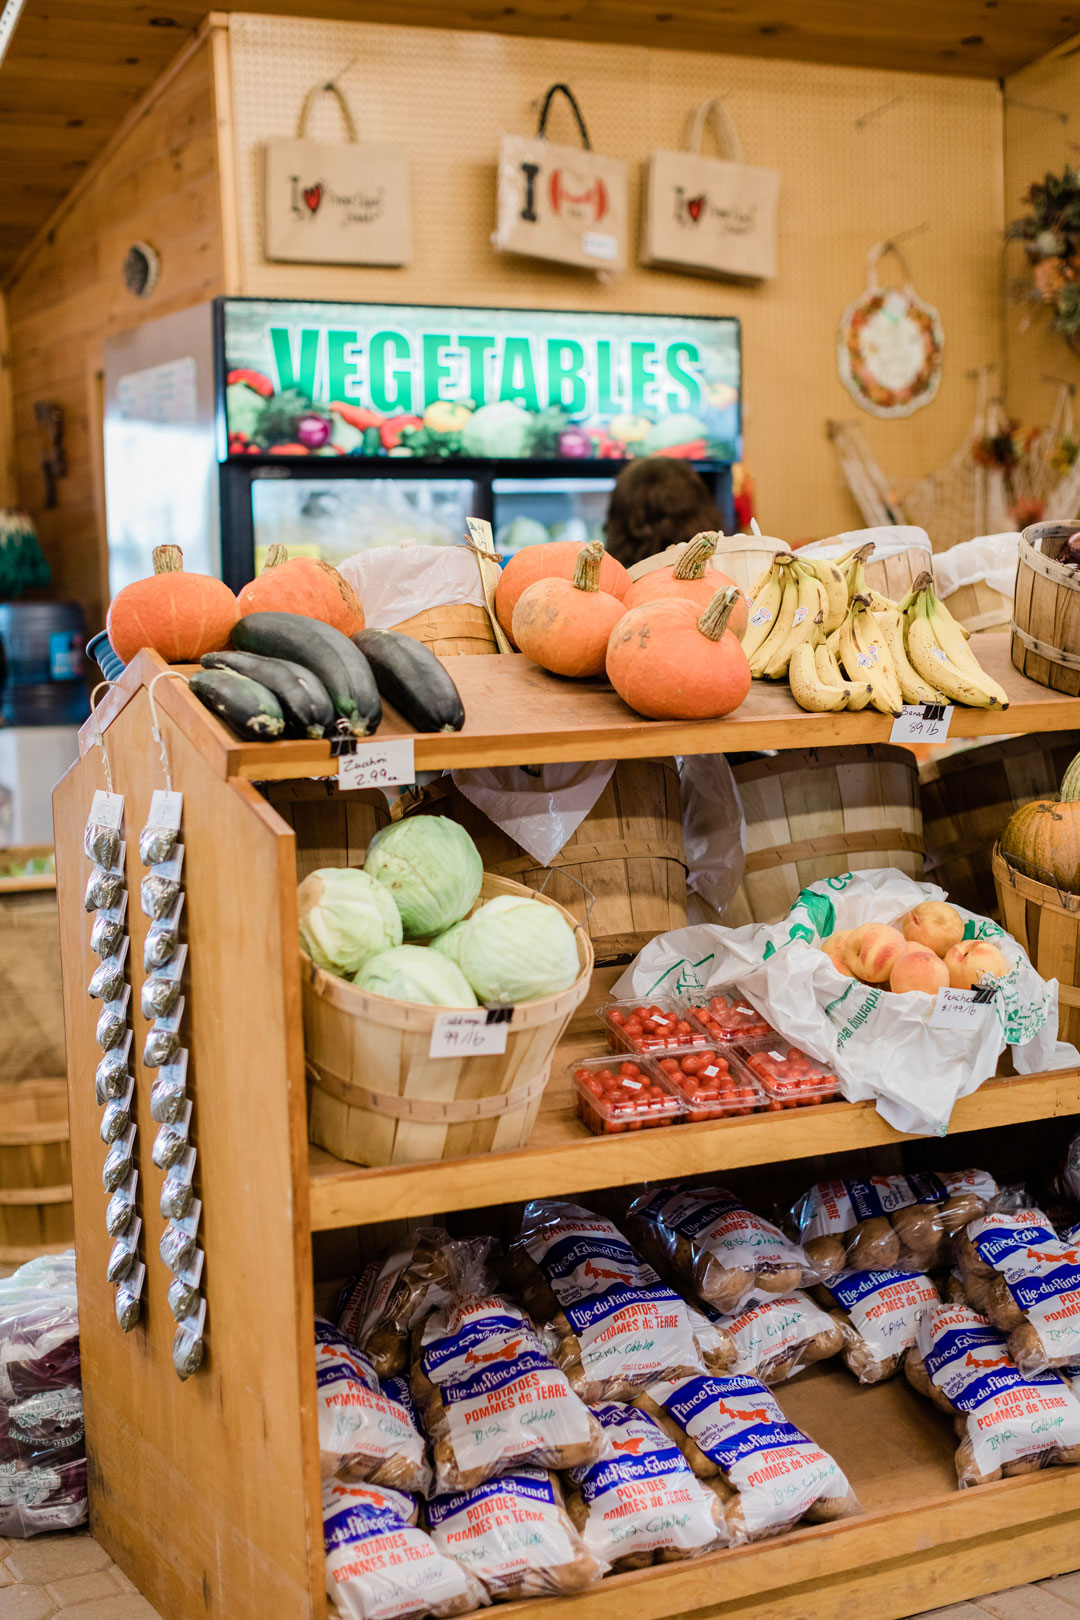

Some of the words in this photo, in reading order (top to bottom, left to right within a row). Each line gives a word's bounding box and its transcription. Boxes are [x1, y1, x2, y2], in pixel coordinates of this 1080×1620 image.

[270, 327, 701, 414] VEGETABLES
[979, 1237, 1017, 1263] Prince
[864, 1297, 906, 1321] POMMES
[906, 1294, 918, 1306] de
[917, 1287, 939, 1302] TERR
[877, 1279, 920, 1301] POTATOES
[612, 1303, 659, 1324] POTATOES
[654, 1315, 679, 1329] TERRE
[325, 1393, 374, 1409] POMMES
[487, 1373, 540, 1404] POTATOES
[670, 1389, 708, 1424] Prince
[702, 1378, 741, 1396] Edward
[993, 1387, 1041, 1409] POTATOES
[464, 1397, 516, 1425] POMMES
[518, 1391, 533, 1405] de
[534, 1384, 568, 1401] TERRE
[976, 1404, 1025, 1431] POMMES
[1025, 1401, 1040, 1414] de
[1039, 1397, 1069, 1411] TERRE
[747, 1460, 791, 1487] POMMES
[790, 1458, 803, 1471] de
[800, 1451, 828, 1465] TERRE
[761, 1446, 801, 1465] POTATOES
[602, 1498, 648, 1521] POMMES
[650, 1495, 664, 1508] de
[664, 1488, 693, 1505] TERRE
[616, 1478, 668, 1502] POTATOES
[466, 1496, 518, 1524] POTATOES
[446, 1515, 493, 1545] POMMES
[510, 1508, 545, 1524] TERRE
[352, 1532, 408, 1560] POTATOES
[331, 1554, 388, 1584] POMMES
[388, 1551, 404, 1567] de
